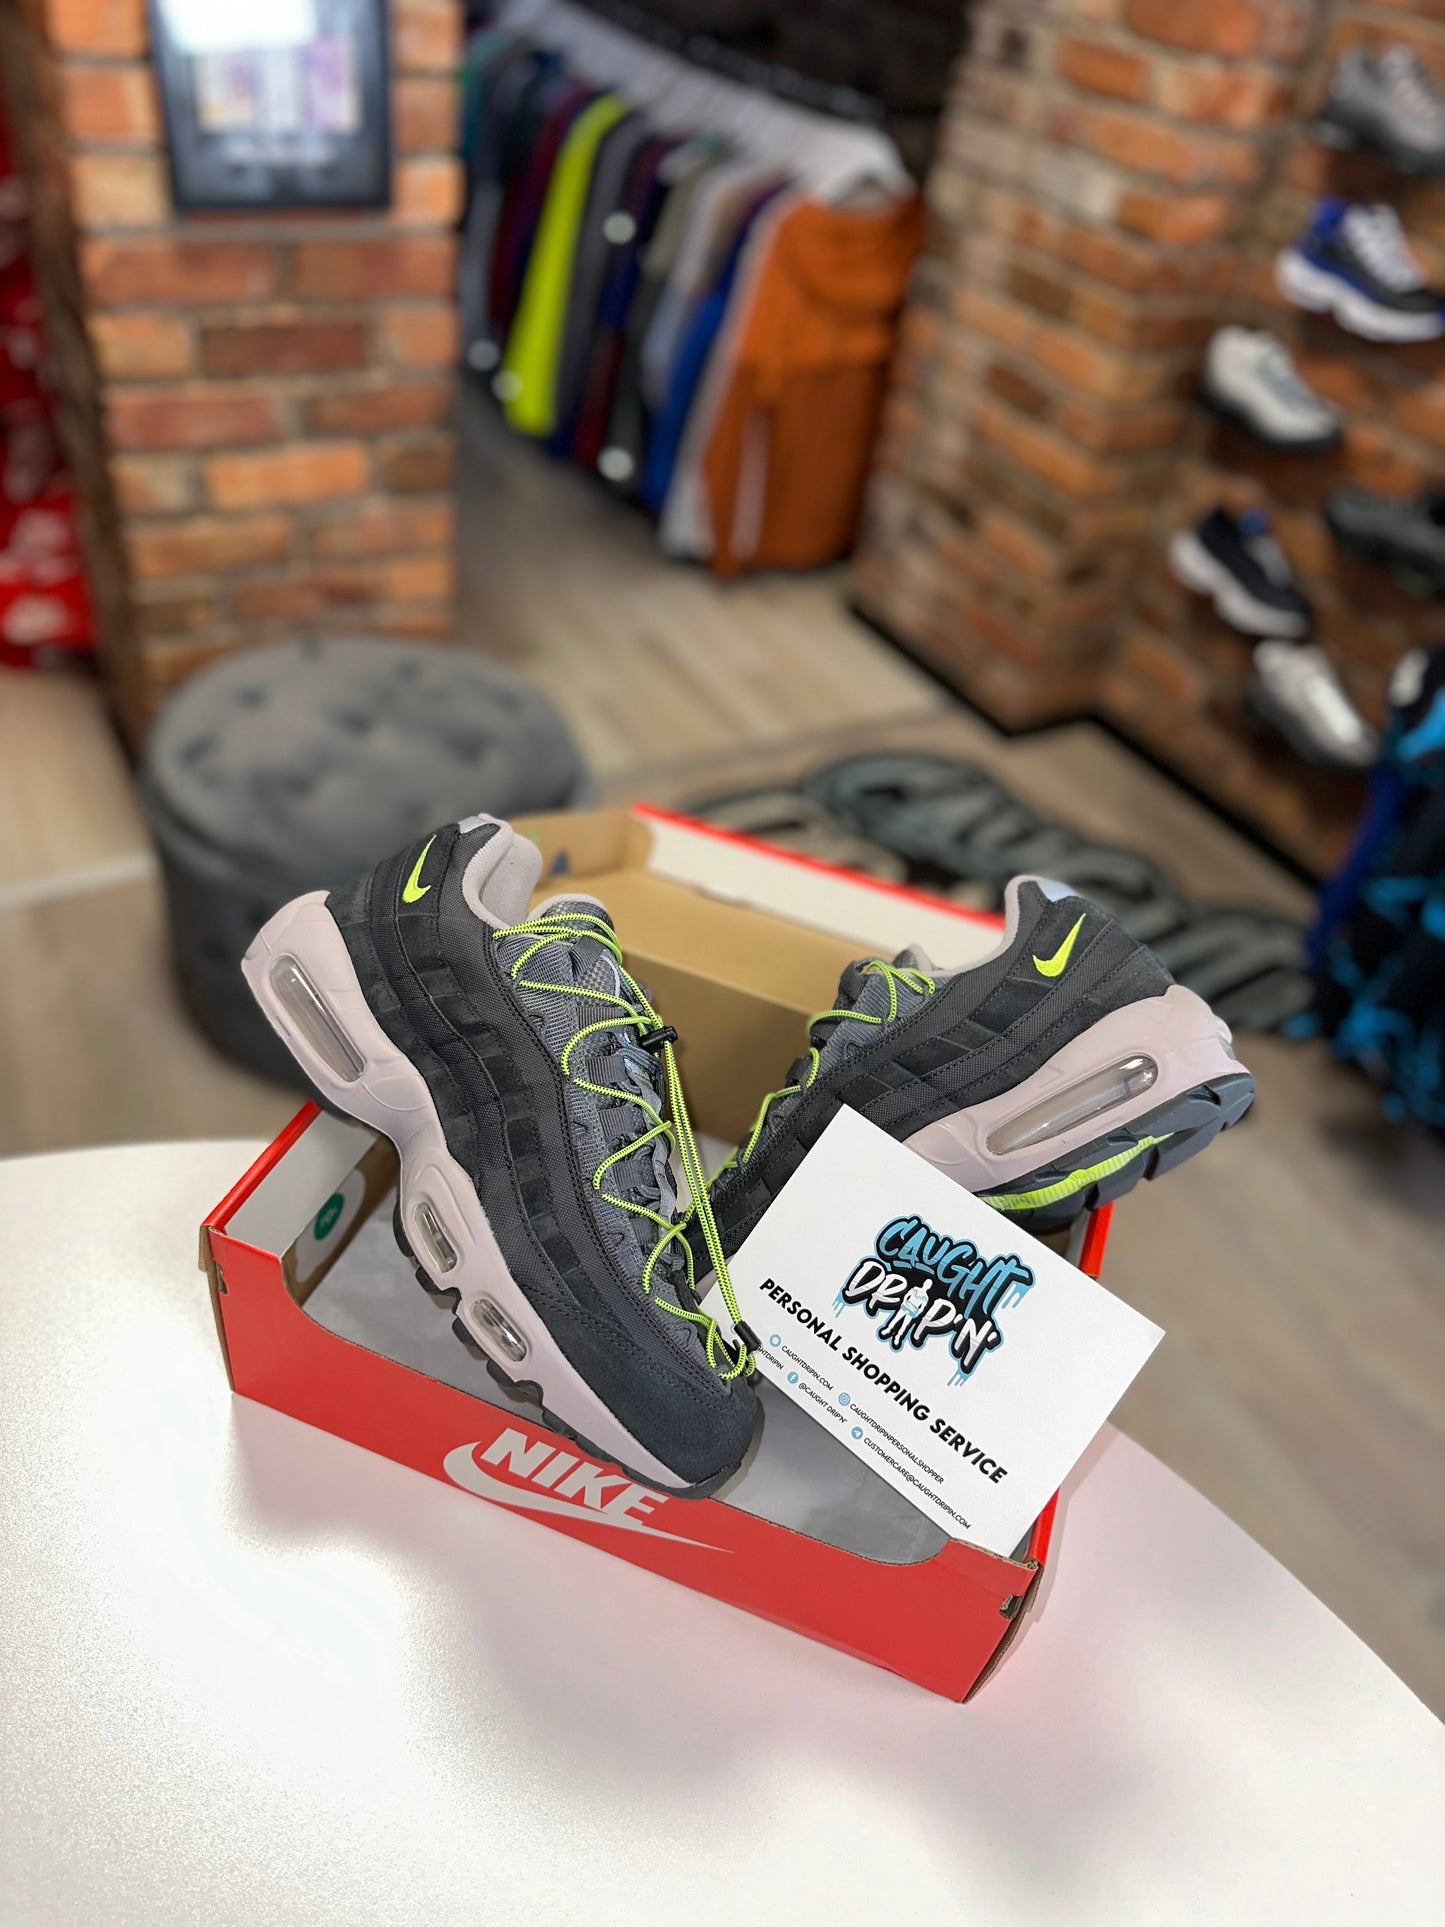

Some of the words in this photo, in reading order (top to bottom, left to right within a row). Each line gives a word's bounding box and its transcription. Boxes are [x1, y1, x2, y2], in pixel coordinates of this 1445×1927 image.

[878, 1218, 1031, 1320] CAUGHT
[759, 1278, 842, 1352] PERSONAL
[843, 1346, 931, 1421] SHOPPING
[930, 1418, 1008, 1484] SERVICE
[781, 1345, 834, 1391] CAUGHTDRIPIN.COM
[798, 1382, 828, 1409] @CAUGHT
[480, 1427, 669, 1525] NIKE
[849, 1403, 945, 1485] CAUGHTDRIPINPERSONALSHOPPER
[863, 1437, 972, 1530] CUSTOMERCARE@CAUGHTDRIPIN.COM
